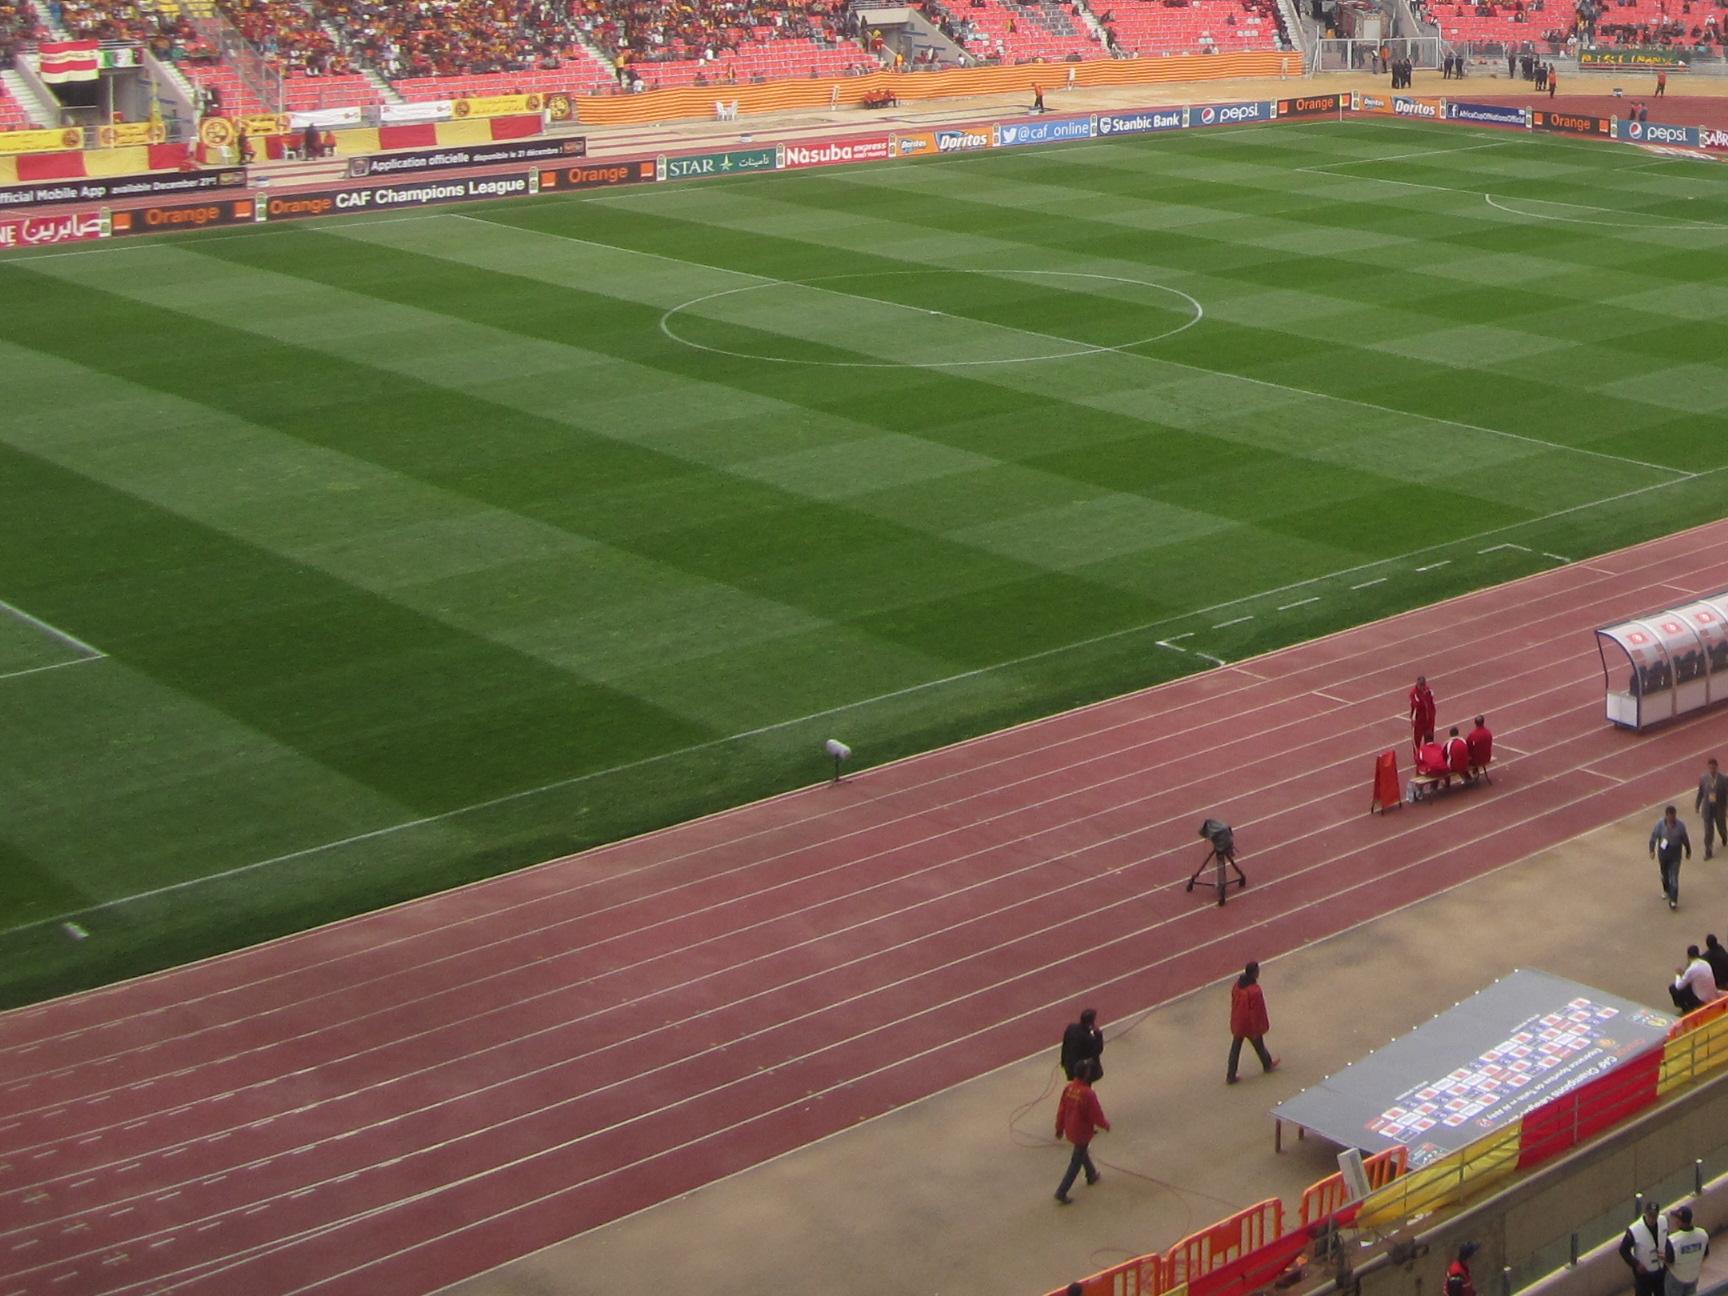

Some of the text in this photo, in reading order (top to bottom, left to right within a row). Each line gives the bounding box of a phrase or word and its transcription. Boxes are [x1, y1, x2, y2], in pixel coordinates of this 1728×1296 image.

[1220, 103, 1258, 122] pepsi
[1296, 97, 1334, 111] Orange
[1395, 100, 1436, 116] Doritos
[1017, 119, 1089, 141] @caf_online
[1112, 112, 1180, 132] Stanbic Bank
[1551, 114, 1591, 132] Orange
[939, 131, 987, 150] Doritos
[1647, 126, 1687, 143] pepsi
[370, 157, 427, 172] Application
[429, 152, 469, 166] officielle
[669, 159, 715, 176] STAR
[568, 166, 629, 183] Orange
[36, 187, 78, 201] Mobile
[81, 186, 106, 198] App
[270, 177, 525, 214] Orange CAF Champions League
[146, 206, 220, 225] Orange
